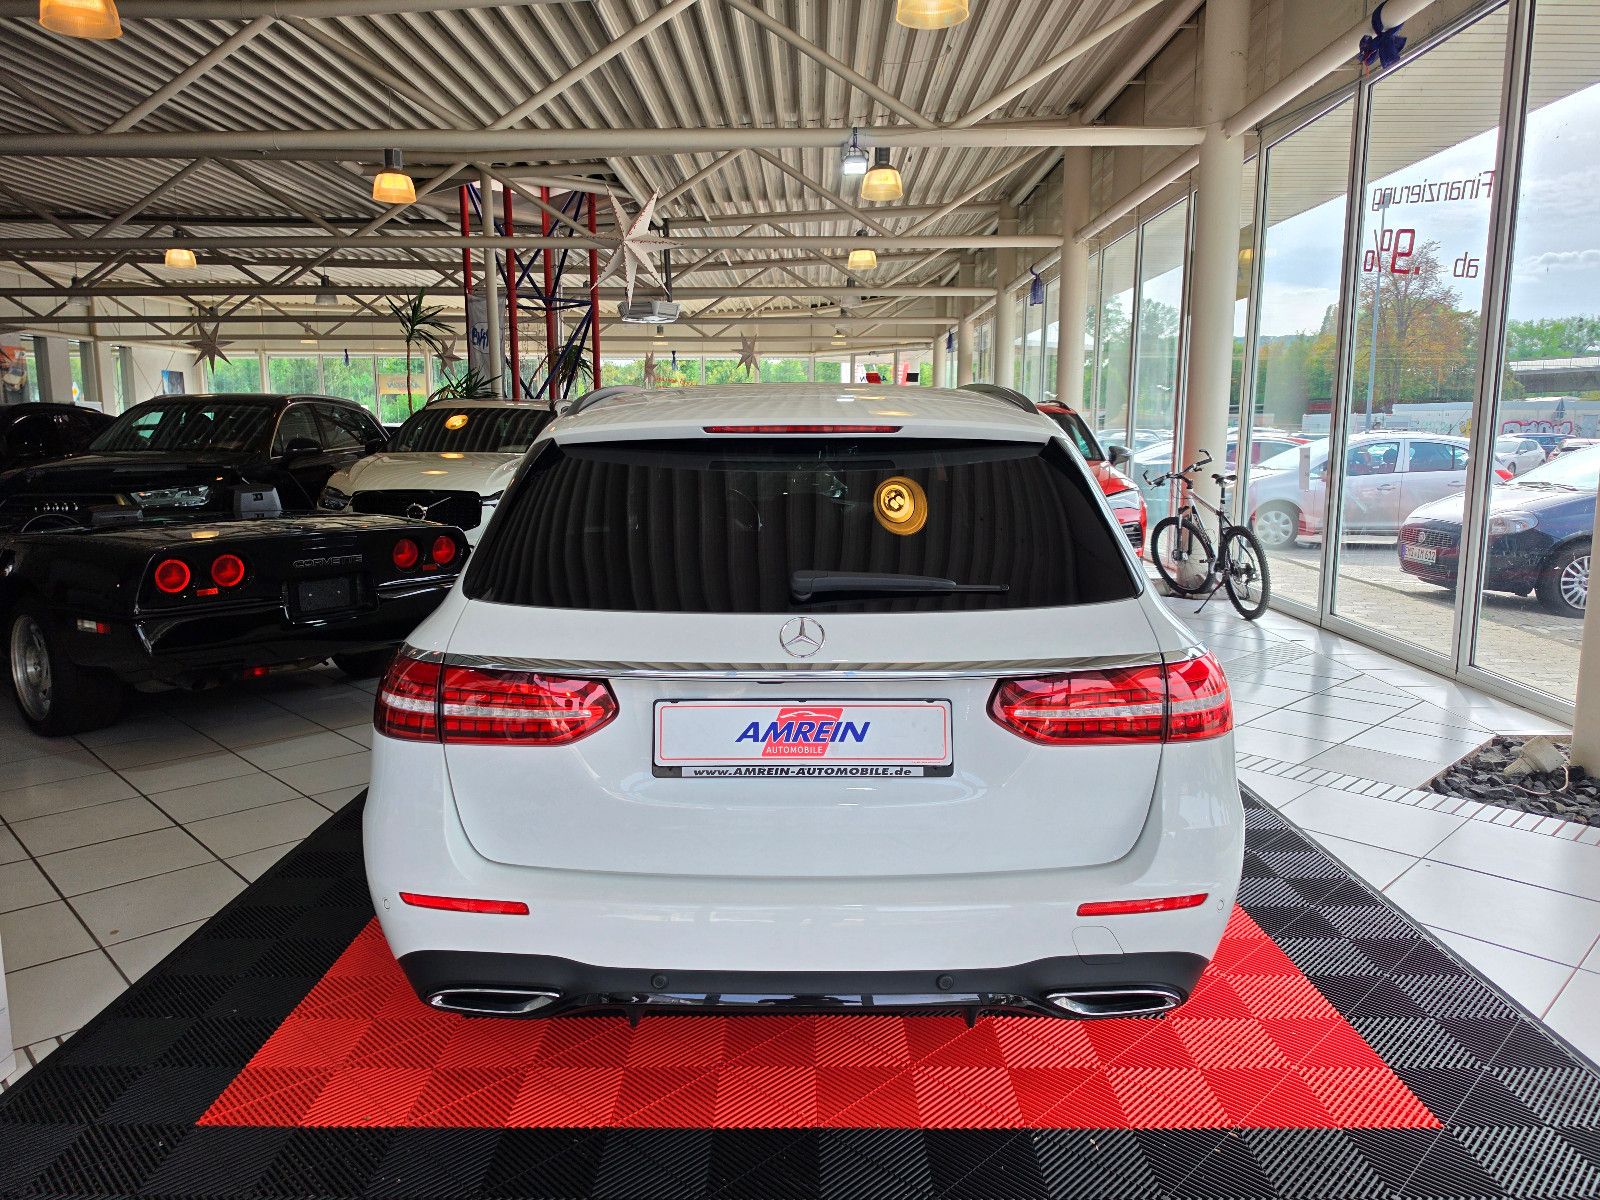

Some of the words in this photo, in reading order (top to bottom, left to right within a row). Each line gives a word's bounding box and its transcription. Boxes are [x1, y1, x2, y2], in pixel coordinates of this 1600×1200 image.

[292, 554, 363, 569] CORVETTE
[735, 721, 870, 743] AMREIN
[765, 746, 823, 754] AUTOMOBILE
[693, 767, 912, 776] www.AMREIN-AUTOMOBILE.de
